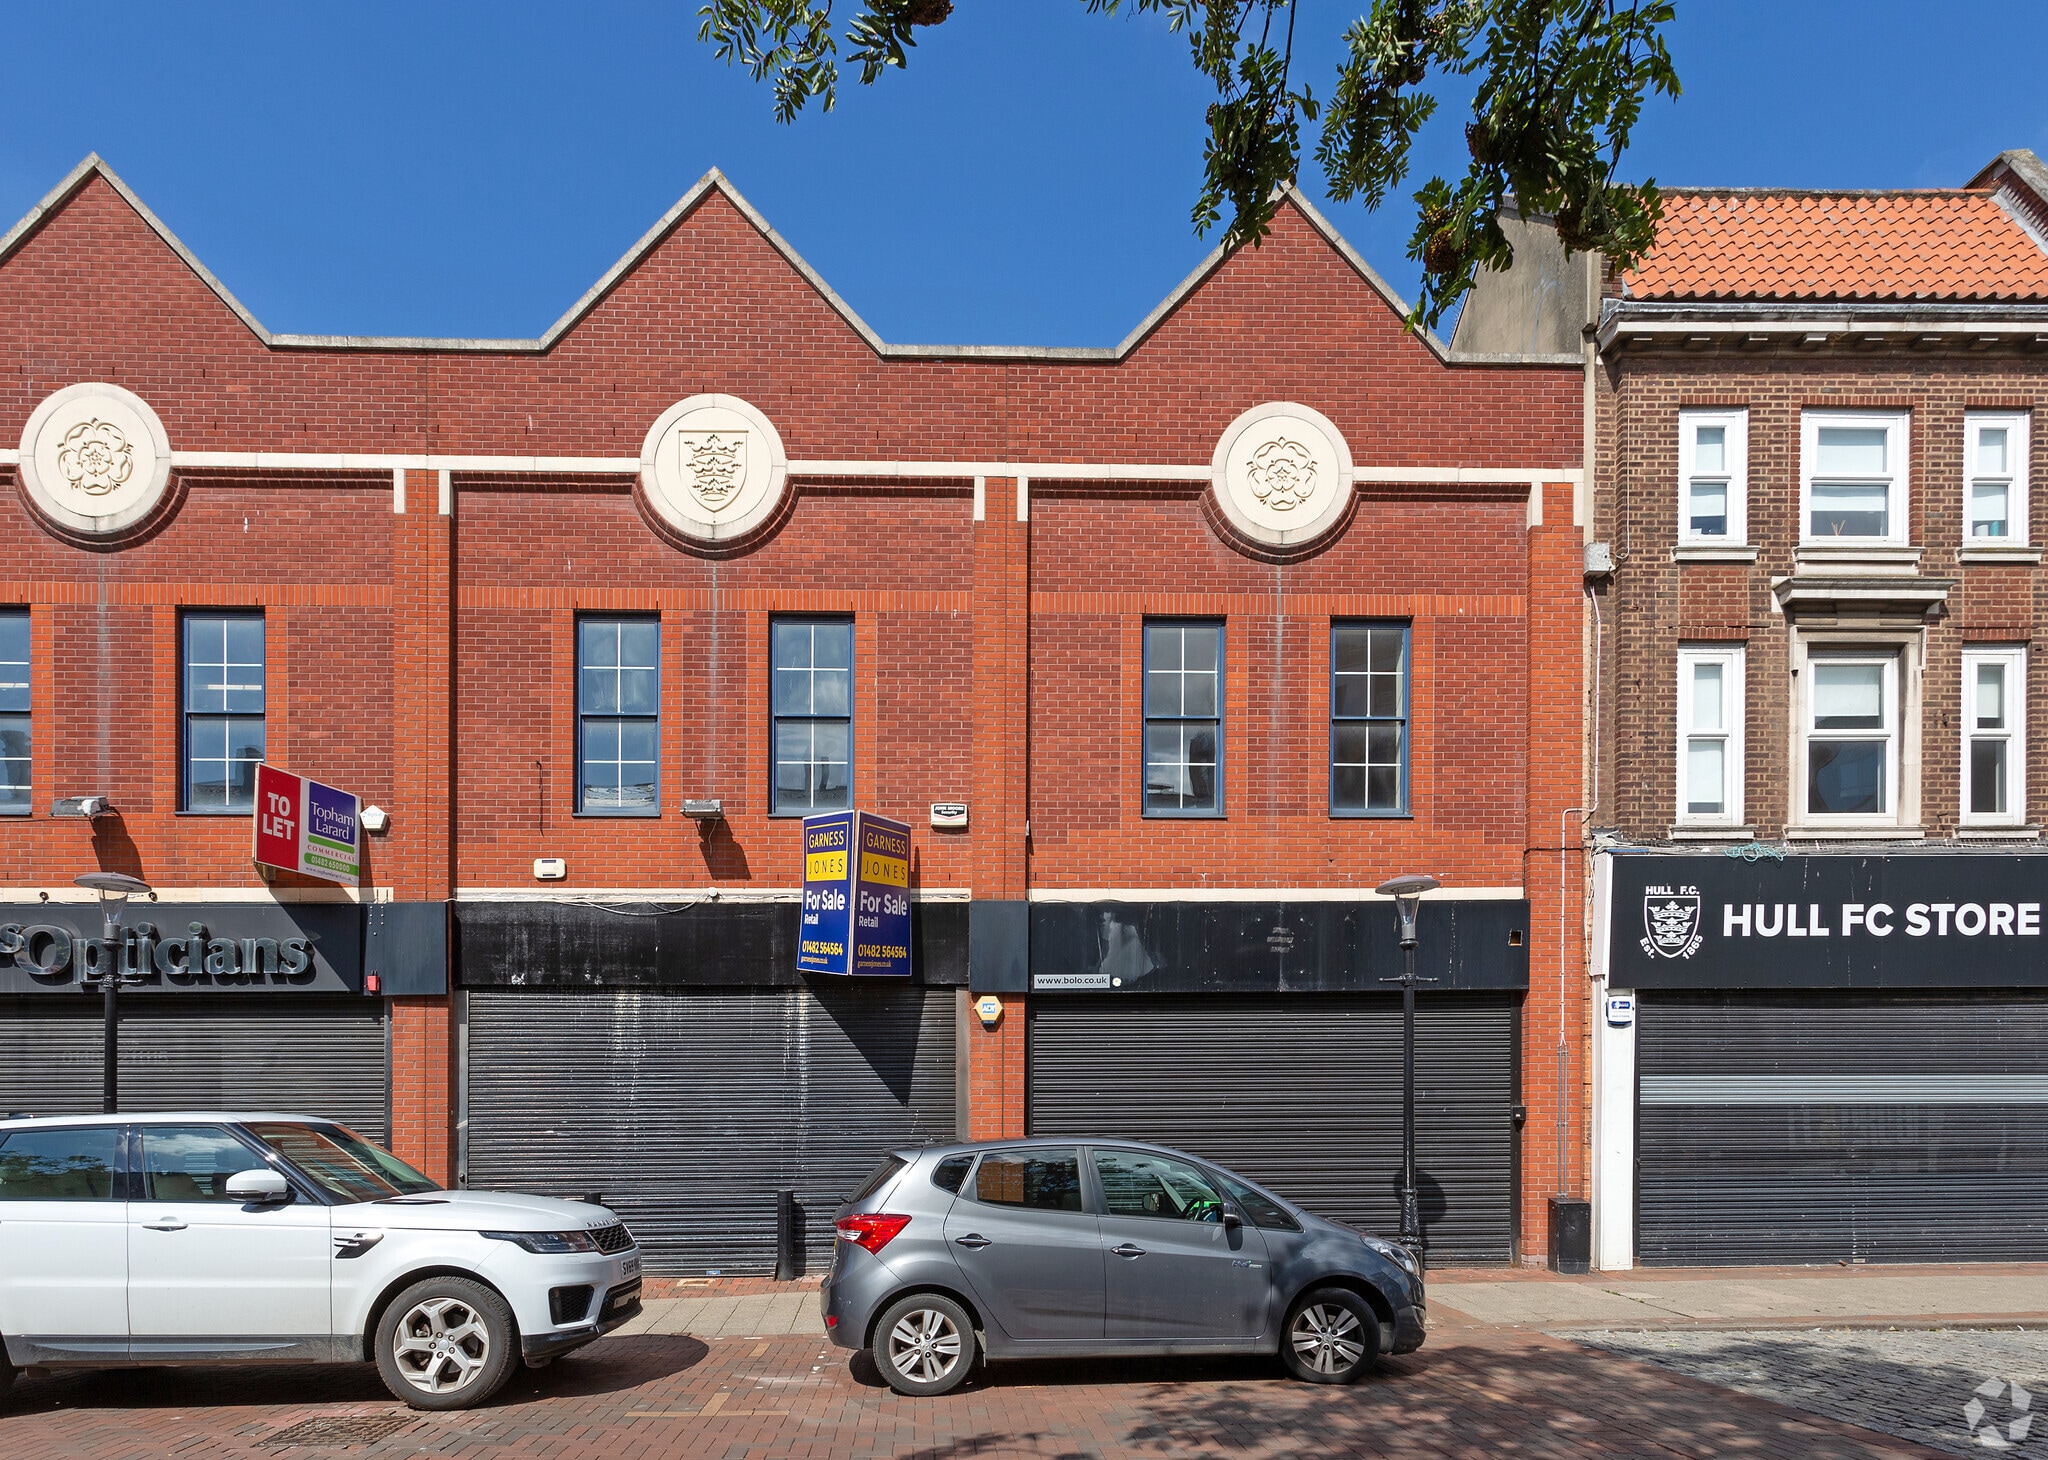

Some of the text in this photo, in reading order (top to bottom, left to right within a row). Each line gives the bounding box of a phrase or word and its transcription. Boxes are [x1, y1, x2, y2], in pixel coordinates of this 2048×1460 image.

[267, 792, 290, 816] TO
[311, 801, 354, 827] Topham
[262, 813, 295, 840] LET
[316, 818, 349, 839] Larard
[808, 830, 844, 848] GARNESS
[866, 832, 906, 854] GARNESS
[307, 845, 355, 862] COMMERCIAL
[311, 856, 350, 872] 01482 650000
[809, 858, 843, 874] JONES
[865, 861, 905, 880] JONES
[805, 888, 845, 910] For Sale
[1645, 885, 1700, 895] HULL F.C.
[860, 890, 907, 916] For Sale
[804, 913, 819, 925] Retail
[858, 915, 878, 928] Retail
[1723, 902, 2041, 937] HULL FC STORE
[14, 921, 312, 985] Opticians
[802, 940, 843, 956] 01482 564564
[858, 943, 907, 959] 01482 564564
[1639, 936, 1655, 959] Est.
[1682, 934, 1703, 959] 1865
[1037, 976, 1107, 984] www.bolo.co.uk
